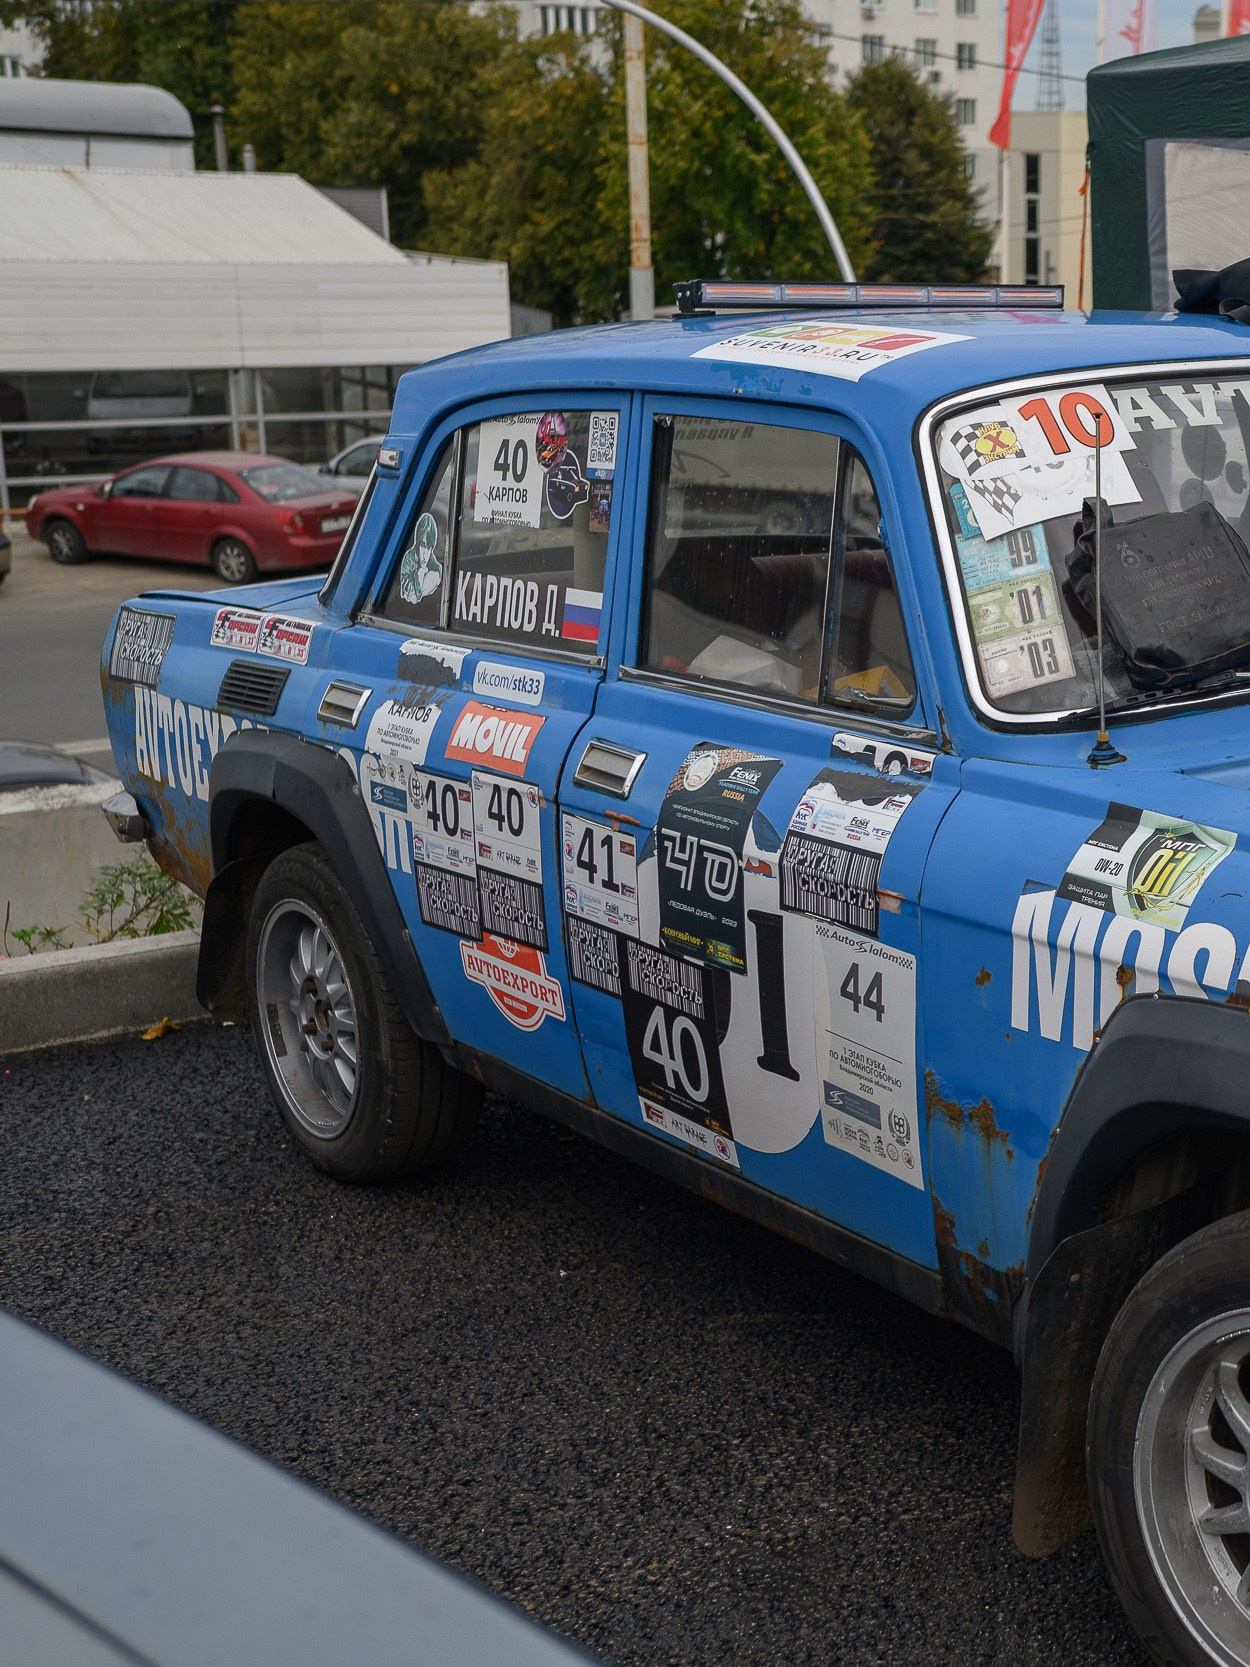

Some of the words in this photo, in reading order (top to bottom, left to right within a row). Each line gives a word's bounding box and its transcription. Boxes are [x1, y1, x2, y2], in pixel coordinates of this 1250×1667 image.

[720, 338, 879, 361] SUVENIR33.RU
[1018, 392, 1115, 455] 10
[493, 439, 529, 483] 40
[983, 445, 1020, 464] ЭКСТРИМ
[488, 486, 528, 503] КАРПОВ
[455, 570, 540, 632] КАРПОВ
[542, 584, 560, 638] Д.
[477, 668, 541, 695] vk.com/stk33
[451, 712, 532, 763] MOVIL
[425, 779, 460, 837] 40
[488, 783, 524, 837] 40
[577, 827, 619, 893] 41
[1160, 839, 1206, 852] МПГ
[800, 874, 875, 911] СКОРОСТЬ
[1067, 884, 1094, 896] ЗАЩИТА
[1095, 891, 1108, 899] ПАР
[1081, 895, 1105, 908] ТРЕНИЯ
[722, 917, 738, 928] 2023
[718, 951, 744, 966] СИСТЕМА
[467, 953, 558, 1006] AVTOEXPORT
[840, 962, 885, 1023] 44
[642, 1005, 709, 1103] 40
[829, 1050, 838, 1060] ПО
[840, 1055, 902, 1088] АВТОМНОГОБОРЬЮ
[848, 1049, 864, 1062] ЭТАП
[866, 1057, 886, 1072] КУБКА
[840, 1064, 873, 1083] Владимирской
[874, 1080, 893, 1092] области
[859, 1083, 874, 1095] 2020
